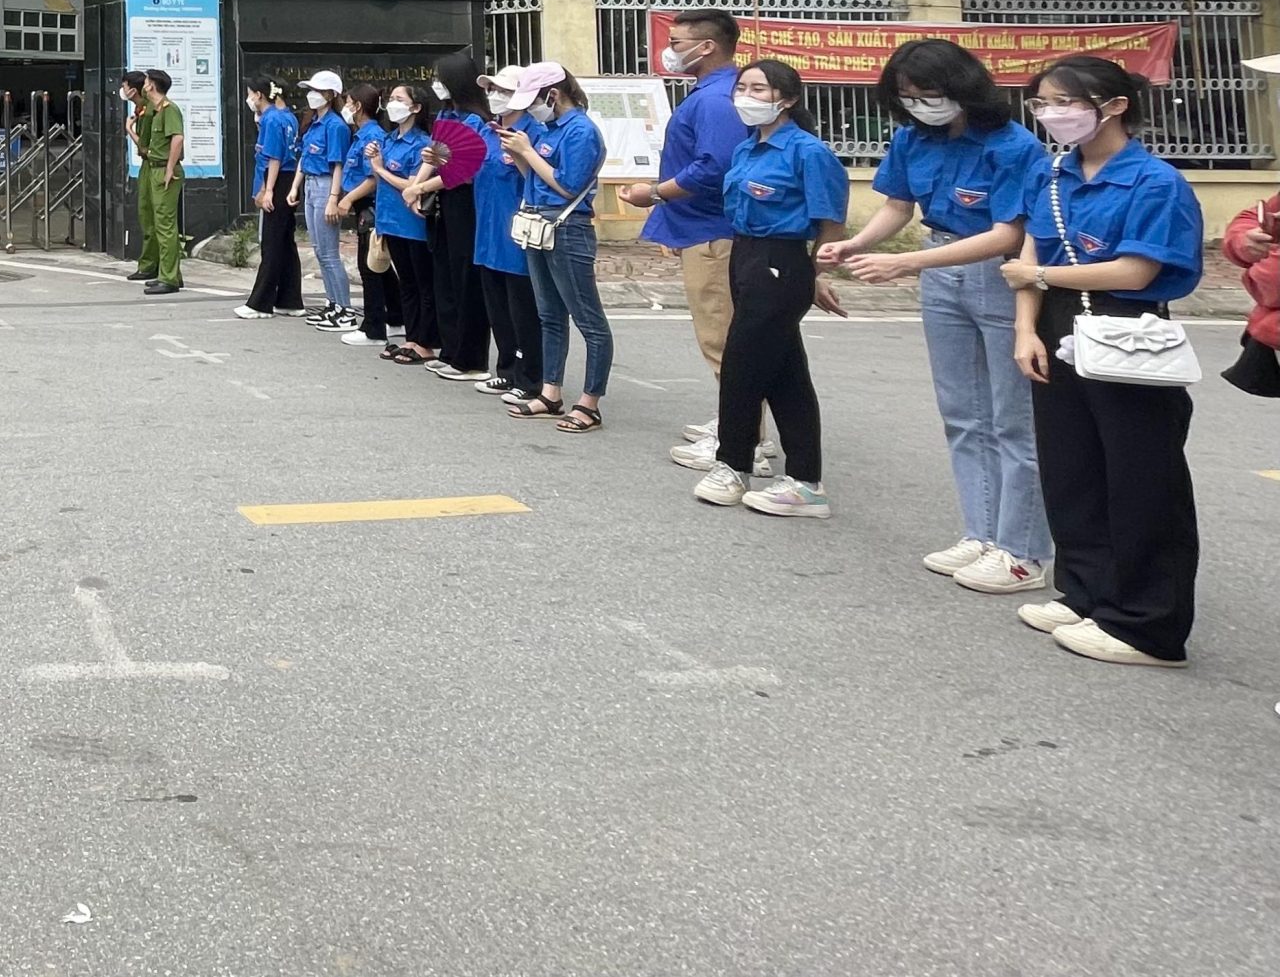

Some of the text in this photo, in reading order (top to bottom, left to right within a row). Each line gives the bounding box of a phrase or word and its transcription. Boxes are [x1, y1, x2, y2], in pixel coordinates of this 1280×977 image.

[770, 26, 795, 46] CHẾ
[797, 31, 824, 49] TẠO,
[827, 26, 853, 47] SẢN
[856, 27, 892, 49] XUẤT,
[843, 53, 876, 72] PHÉP
